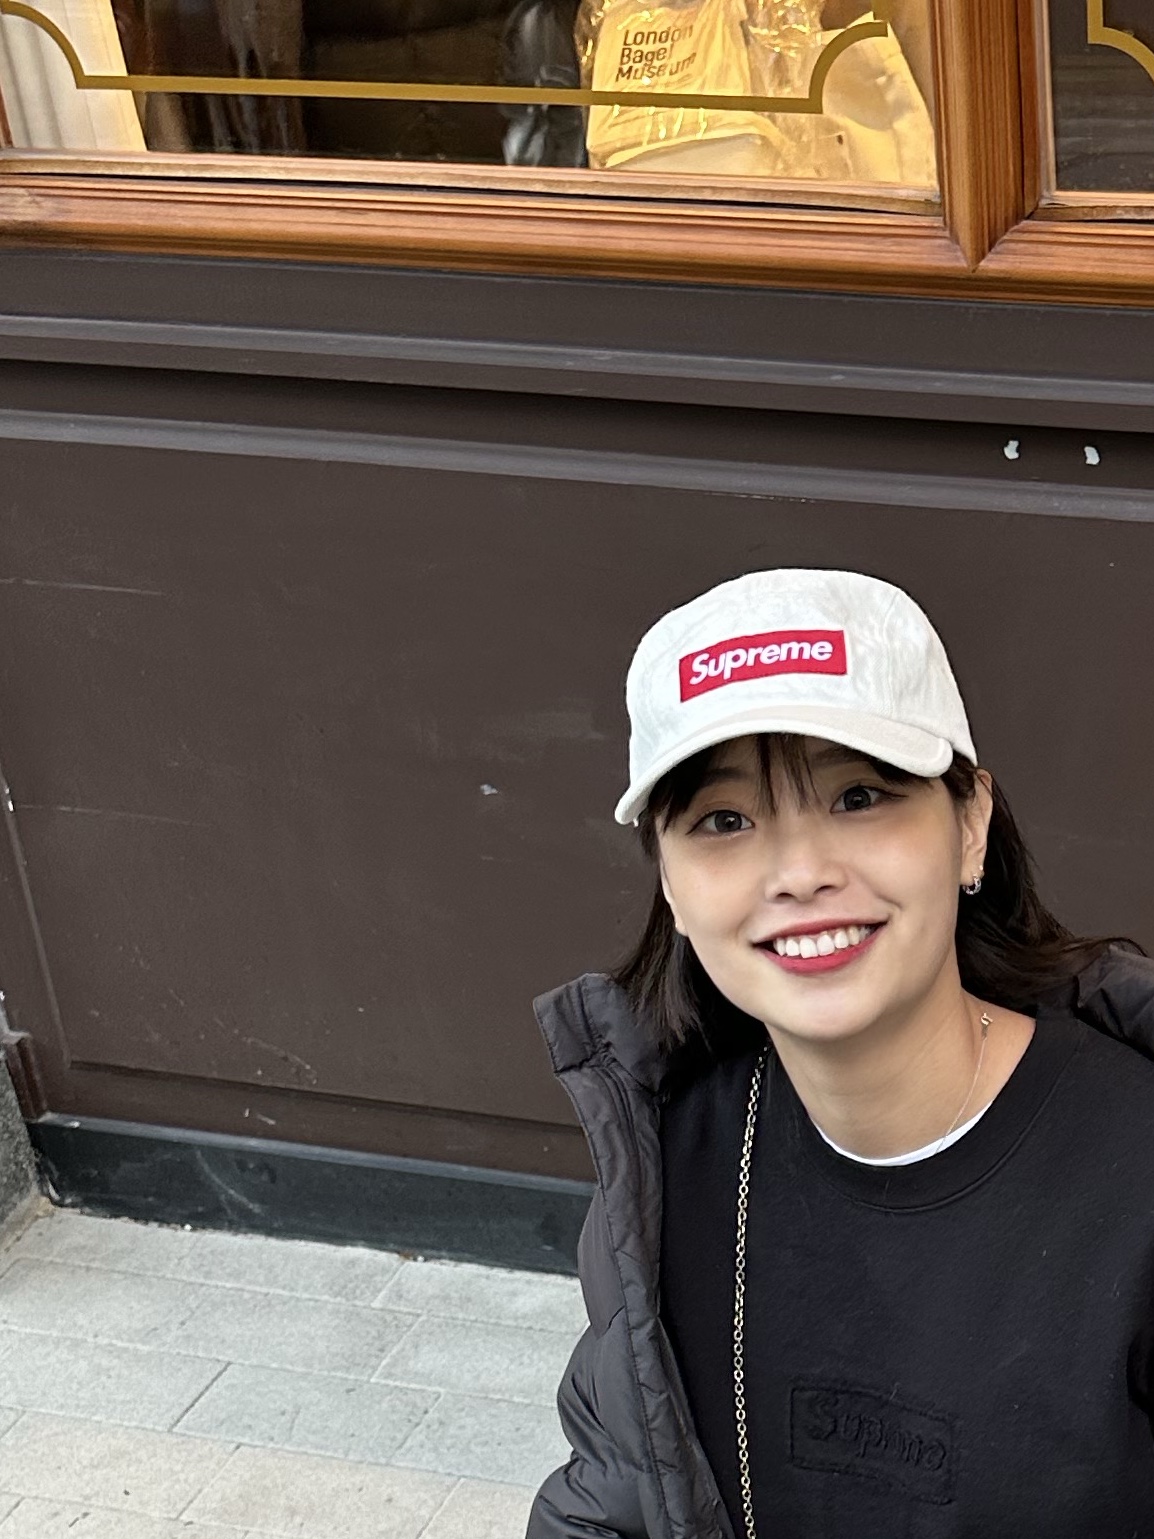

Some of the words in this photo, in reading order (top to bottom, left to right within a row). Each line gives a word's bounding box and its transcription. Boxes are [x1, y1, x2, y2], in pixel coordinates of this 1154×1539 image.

[623, 25, 693, 46] London
[615, 52, 697, 82] Museum
[619, 42, 674, 66] Bagel
[690, 641, 833, 685] Supreme
